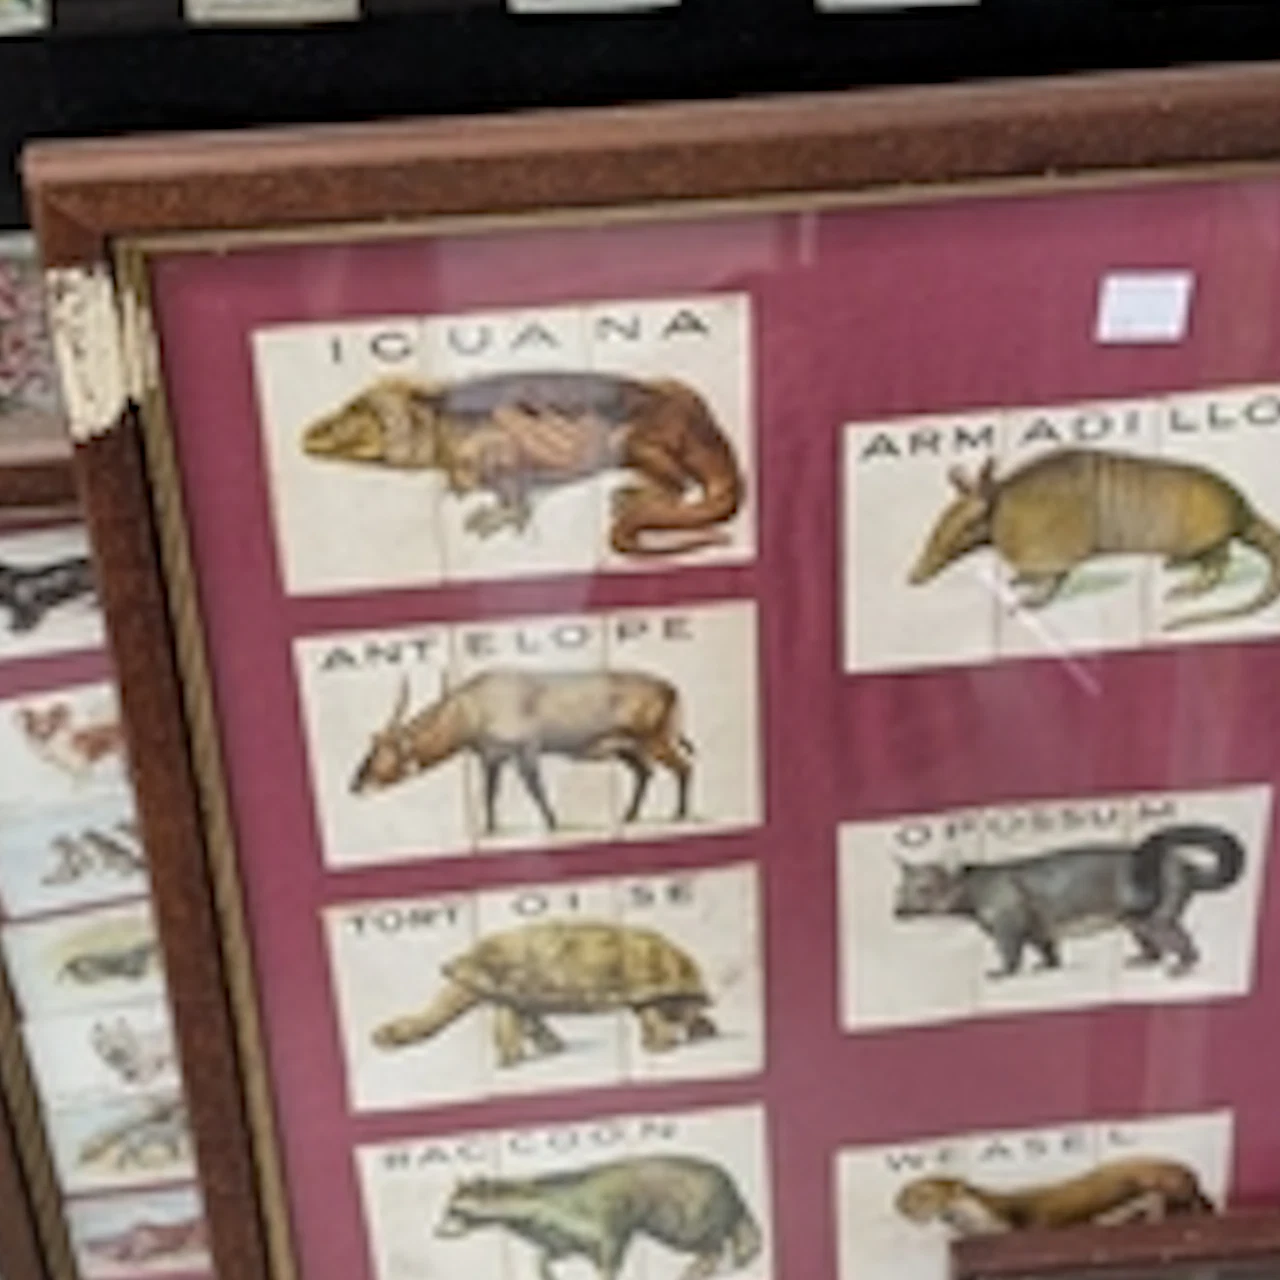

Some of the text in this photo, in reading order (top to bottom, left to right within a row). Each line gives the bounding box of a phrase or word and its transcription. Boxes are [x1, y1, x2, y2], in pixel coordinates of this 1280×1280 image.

[329, 309, 711, 364] IGUANA
[319, 617, 695, 672] ANTELOPE
[893, 798, 1178, 848] OPOSSUM
[380, 1121, 678, 1170] RACCOON
[884, 1126, 1138, 1171] WEASEL
